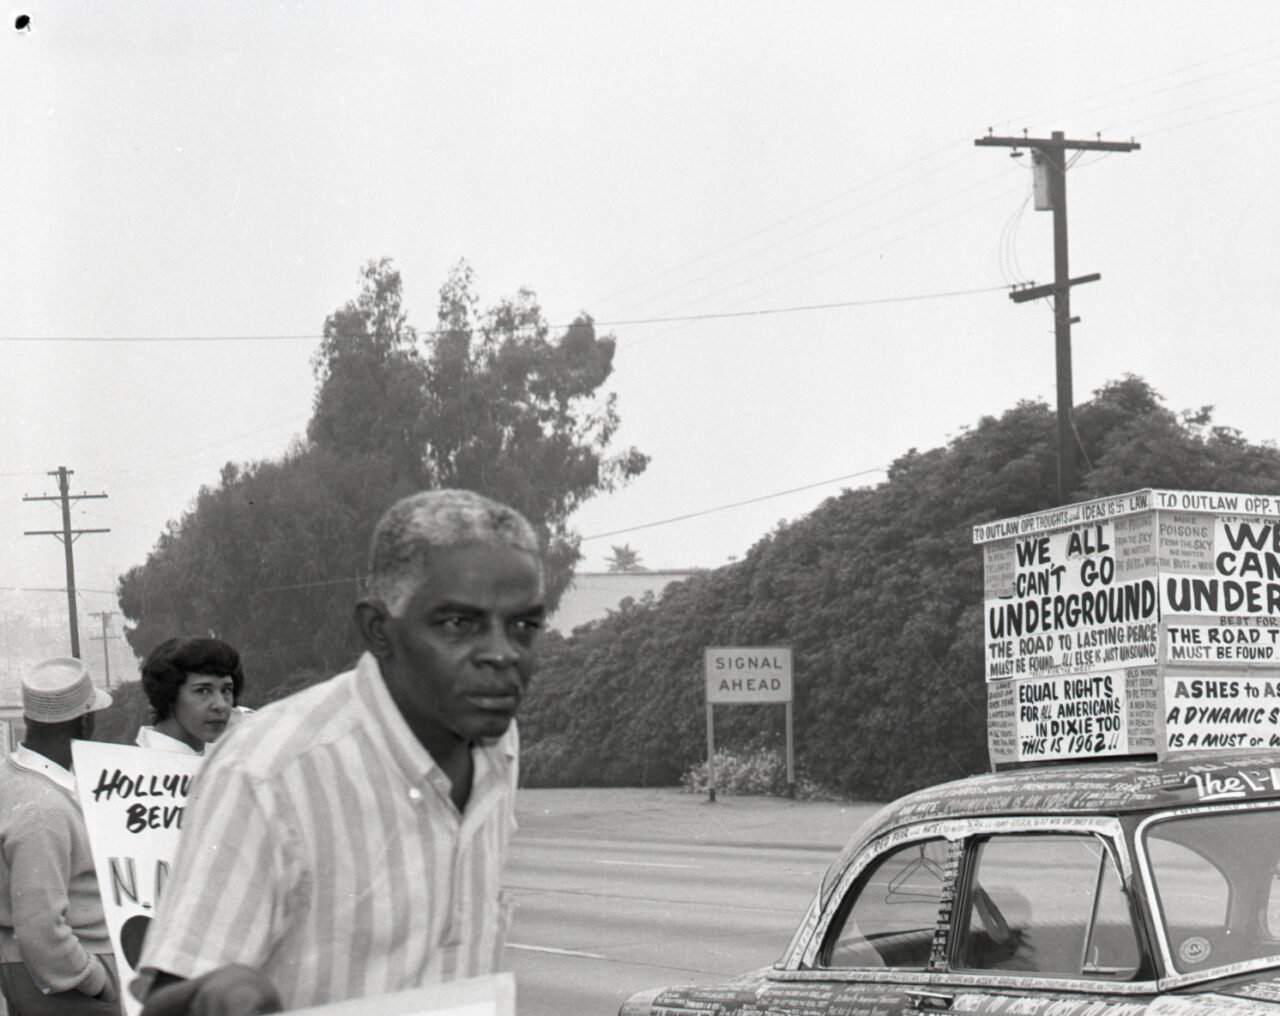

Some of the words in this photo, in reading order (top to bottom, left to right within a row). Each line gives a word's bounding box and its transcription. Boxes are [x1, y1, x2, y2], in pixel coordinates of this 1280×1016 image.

[1158, 493, 1177, 507] TO
[1182, 494, 1238, 509] OUTLAW
[1160, 524, 1208, 536] POISONS
[1016, 538, 1050, 567] WE
[1068, 526, 1109, 556] ALL
[1016, 563, 1065, 598] CAN'T
[1081, 556, 1115, 587] GO
[990, 580, 1155, 639] UNDERGROUND
[1220, 617, 1248, 625] BEST
[1256, 617, 1278, 625] FOR
[989, 641, 1013, 658] THE
[1020, 636, 1054, 656] ROAD
[1058, 634, 1072, 650] TO
[1077, 626, 1125, 648] LASTING
[1127, 624, 1156, 642] PEACE
[1168, 628, 1201, 643] THE
[1208, 628, 1260, 643] ROAD
[990, 661, 1014, 677] MUST
[1016, 658, 1026, 672] BE
[1062, 652, 1073, 666] ALL
[1076, 650, 1093, 665] ELSE
[1095, 649, 1101, 662] IS
[1103, 647, 1118, 663] JUST
[1172, 647, 1212, 659] MUST
[1216, 647, 1232, 658] BE
[716, 657, 782, 669] SIGNAL
[720, 679, 780, 691] AHEAD
[1019, 681, 1058, 703] EQUAL
[1064, 676, 1113, 699] RIGHTS
[1175, 680, 1239, 698] ASHES
[1244, 682, 1259, 698] to
[1021, 707, 1038, 722] FOR
[1041, 704, 1051, 719] ALL
[1058, 698, 1120, 719] AMERICANS
[1167, 707, 1180, 724] A
[1185, 707, 1265, 724] DYNAMIC
[1052, 718, 1092, 736] DIXIE
[1097, 716, 1120, 732] TOO
[1022, 737, 1047, 755] THIS
[1050, 737, 1063, 753] IS
[1169, 734, 1184, 747] IS
[1188, 734, 1198, 746] A
[1202, 734, 1248, 747] MUST
[1250, 737, 1263, 747] or
[1184, 772, 1246, 797] The
